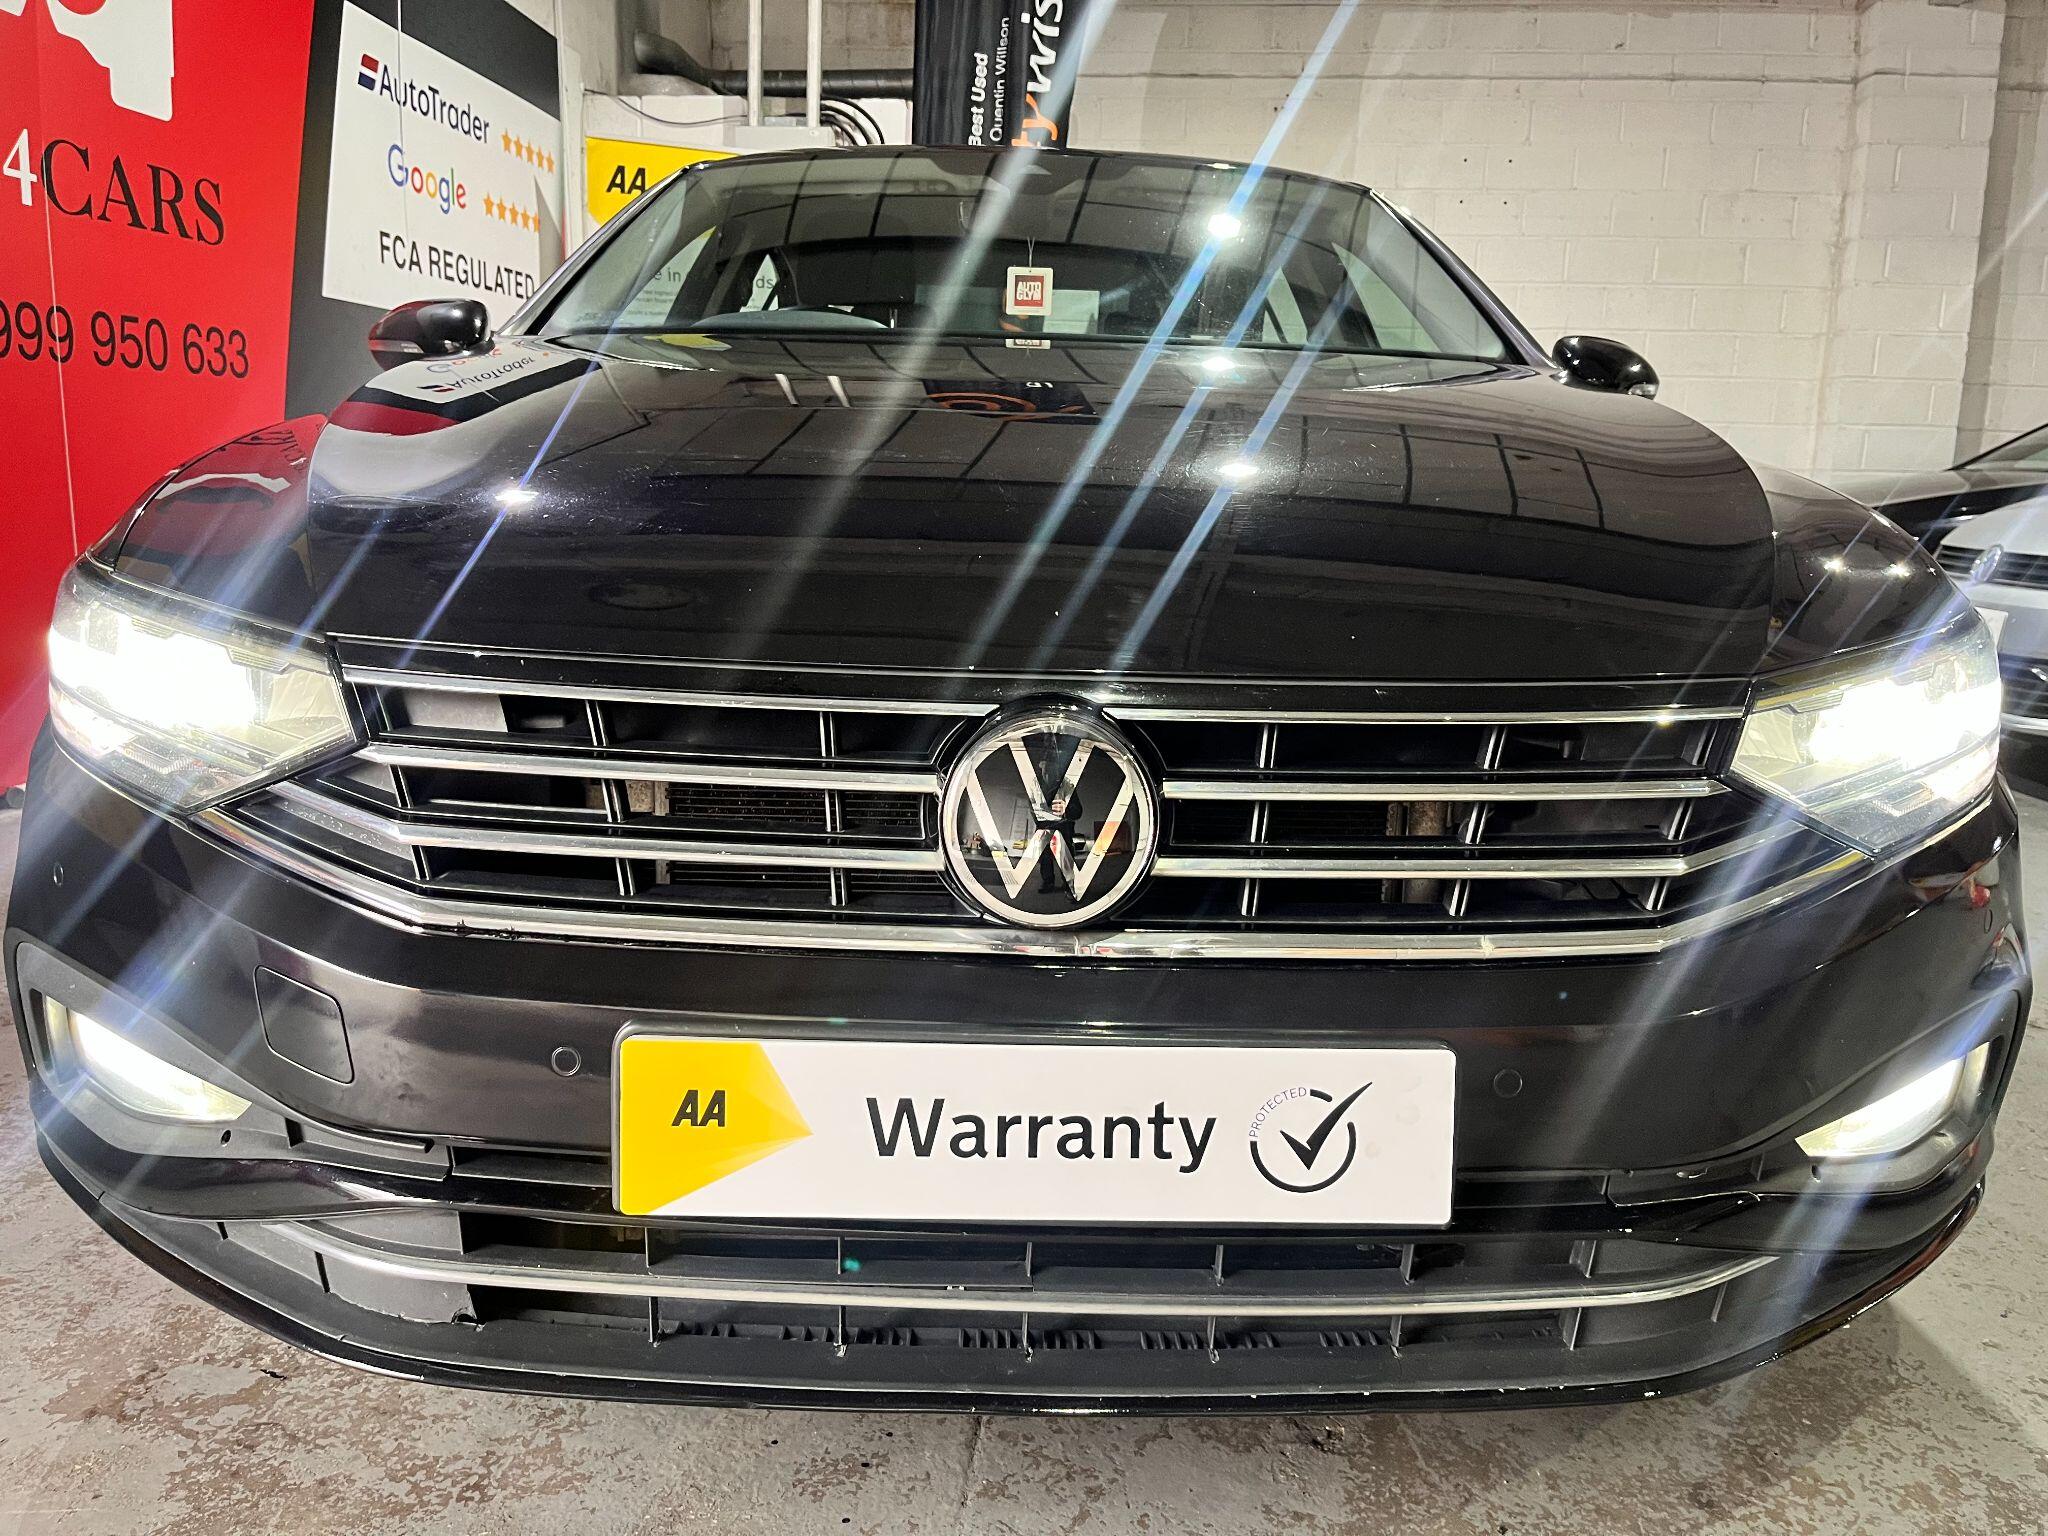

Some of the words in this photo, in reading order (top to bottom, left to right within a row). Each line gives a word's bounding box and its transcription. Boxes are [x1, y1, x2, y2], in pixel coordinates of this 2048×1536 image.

[971, 52, 988, 102] Used
[995, 17, 1010, 76] Willson
[380, 64, 489, 144] AutoTrader
[990, 79, 1006, 142] Quentin
[388, 144, 466, 214] Google
[606, 165, 647, 195] AA
[379, 231, 422, 275] FCA
[429, 245, 535, 299] REGULATED
[91, 311, 168, 371] 950
[183, 323, 249, 378] 633
[671, 1089, 726, 1128] AA
[866, 1097, 1216, 1173] Warranty
[1248, 1086, 1307, 1138] PROTECTED
